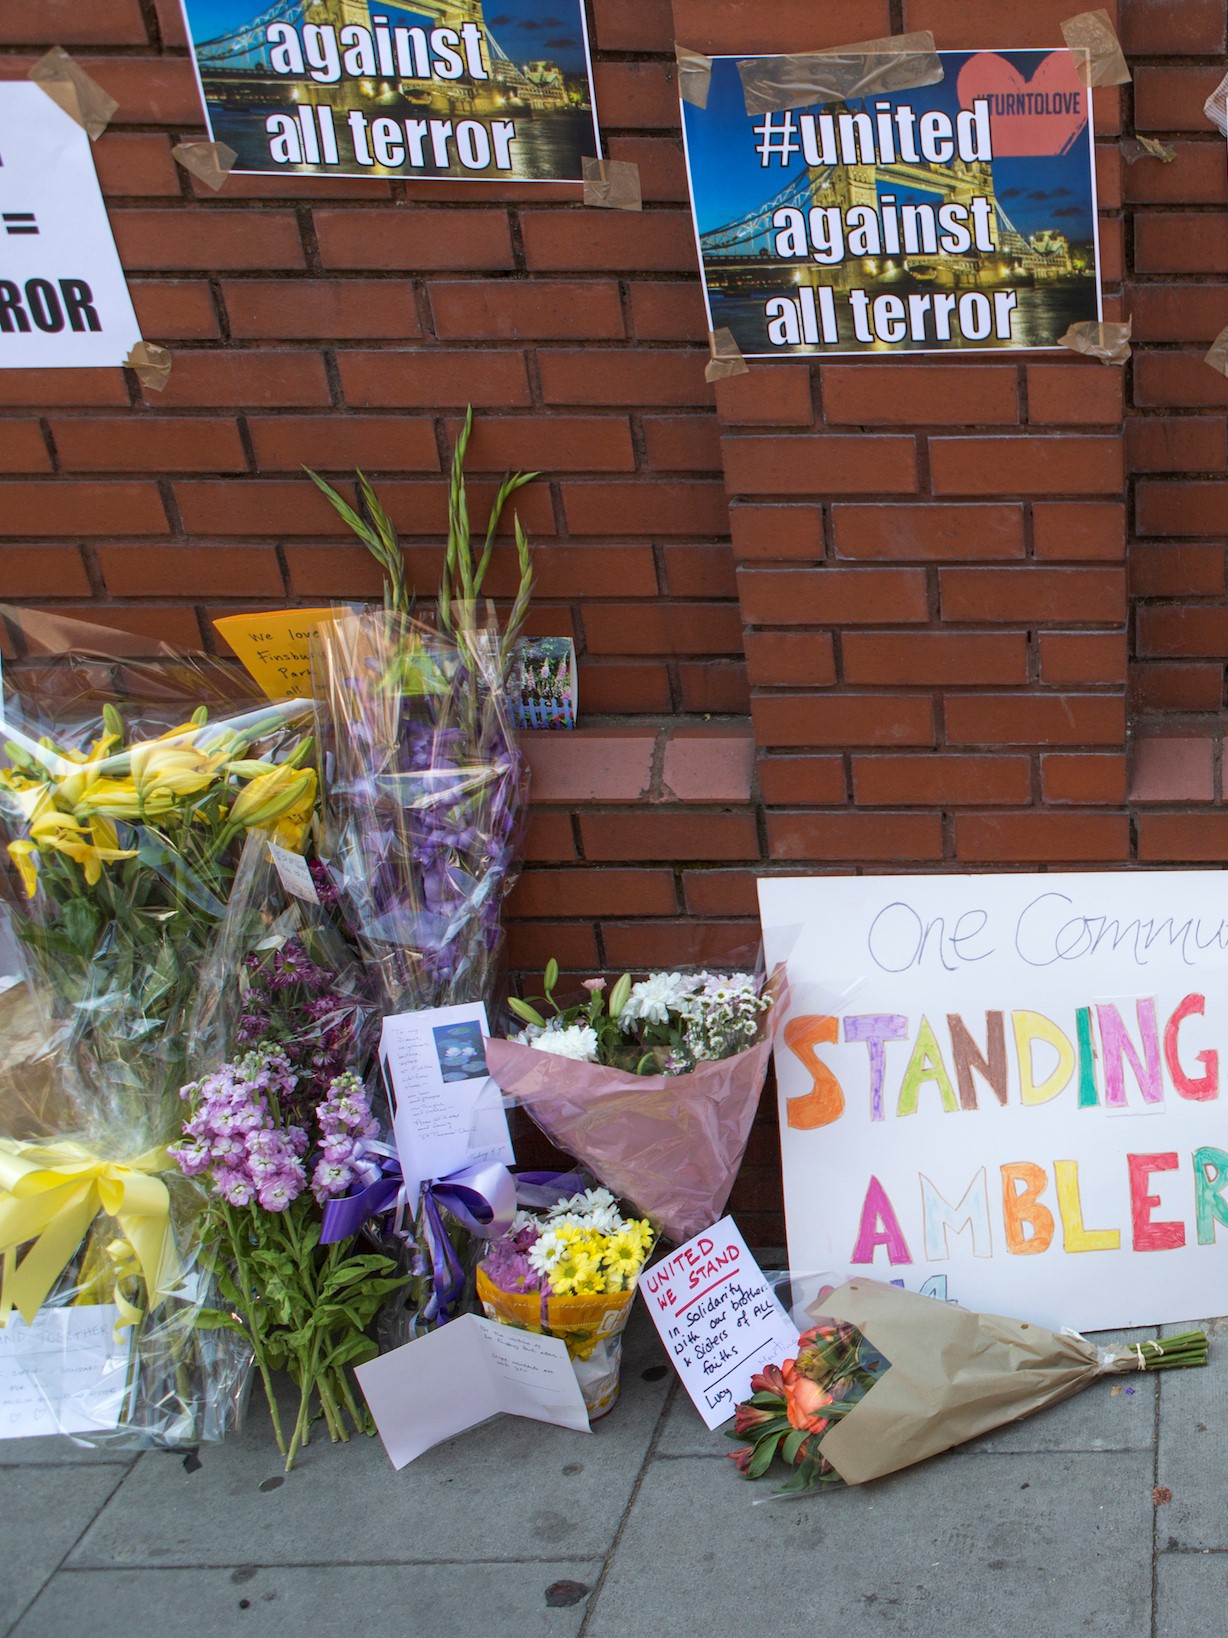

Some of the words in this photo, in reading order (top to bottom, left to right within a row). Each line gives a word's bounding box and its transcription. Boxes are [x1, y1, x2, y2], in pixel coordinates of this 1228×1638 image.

[266, 15, 488, 83] against
[266, 104, 337, 165] all
[348, 108, 516, 170] terror
[752, 99, 993, 168] #united
[772, 195, 996, 264] against
[765, 285, 839, 346] all
[849, 287, 1018, 344] terror
[868, 901, 996, 973] One
[784, 992, 1219, 1130] STANDING
[647, 1238, 714, 1294] UNITED
[656, 1290, 677, 1311] WE
[689, 1244, 740, 1289] STAND
